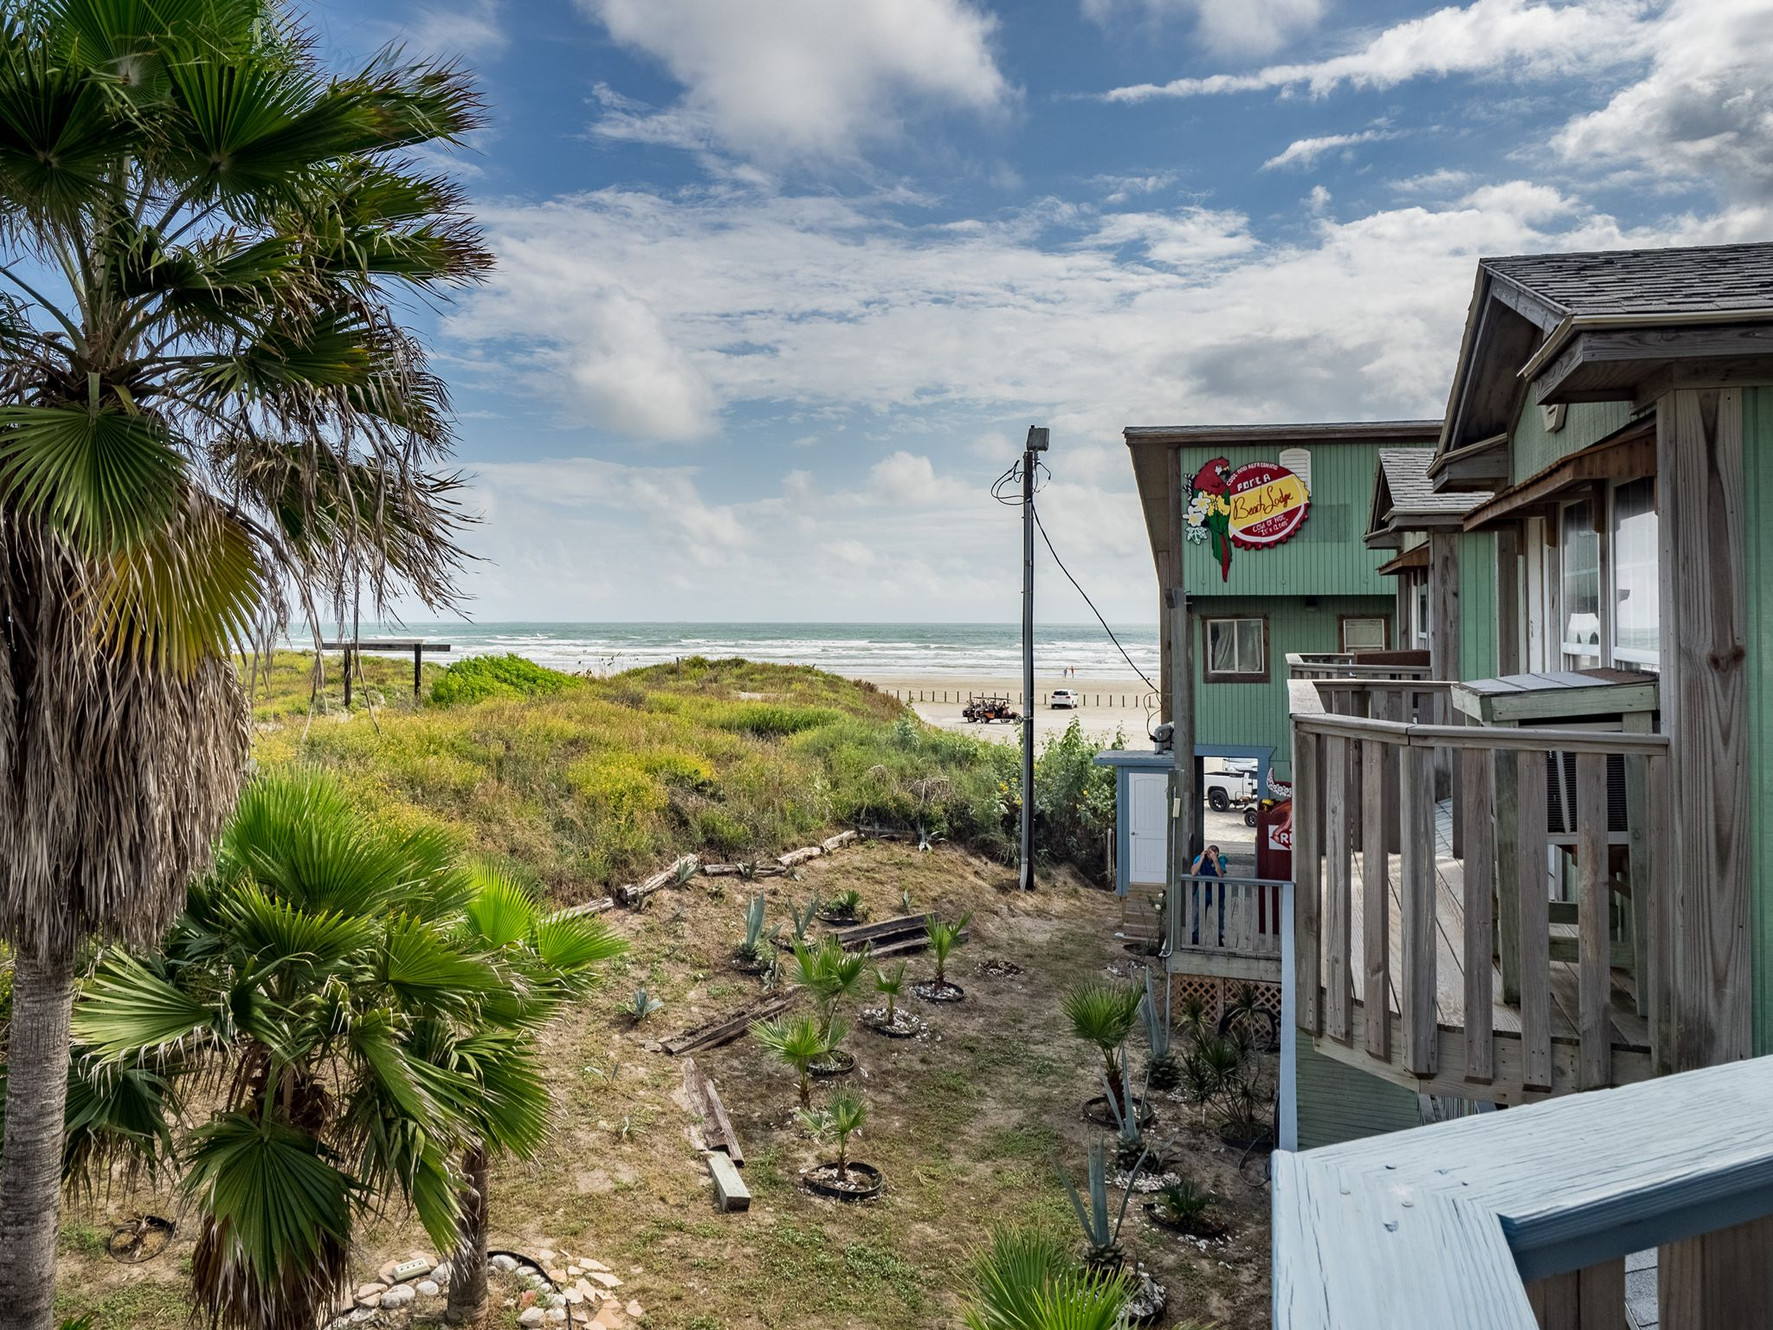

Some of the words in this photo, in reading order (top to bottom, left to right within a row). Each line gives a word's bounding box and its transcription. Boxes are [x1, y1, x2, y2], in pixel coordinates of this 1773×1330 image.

[1263, 473, 1271, 483] A
[1233, 495, 1265, 520] Beach
[1264, 485, 1294, 514] Lodge
